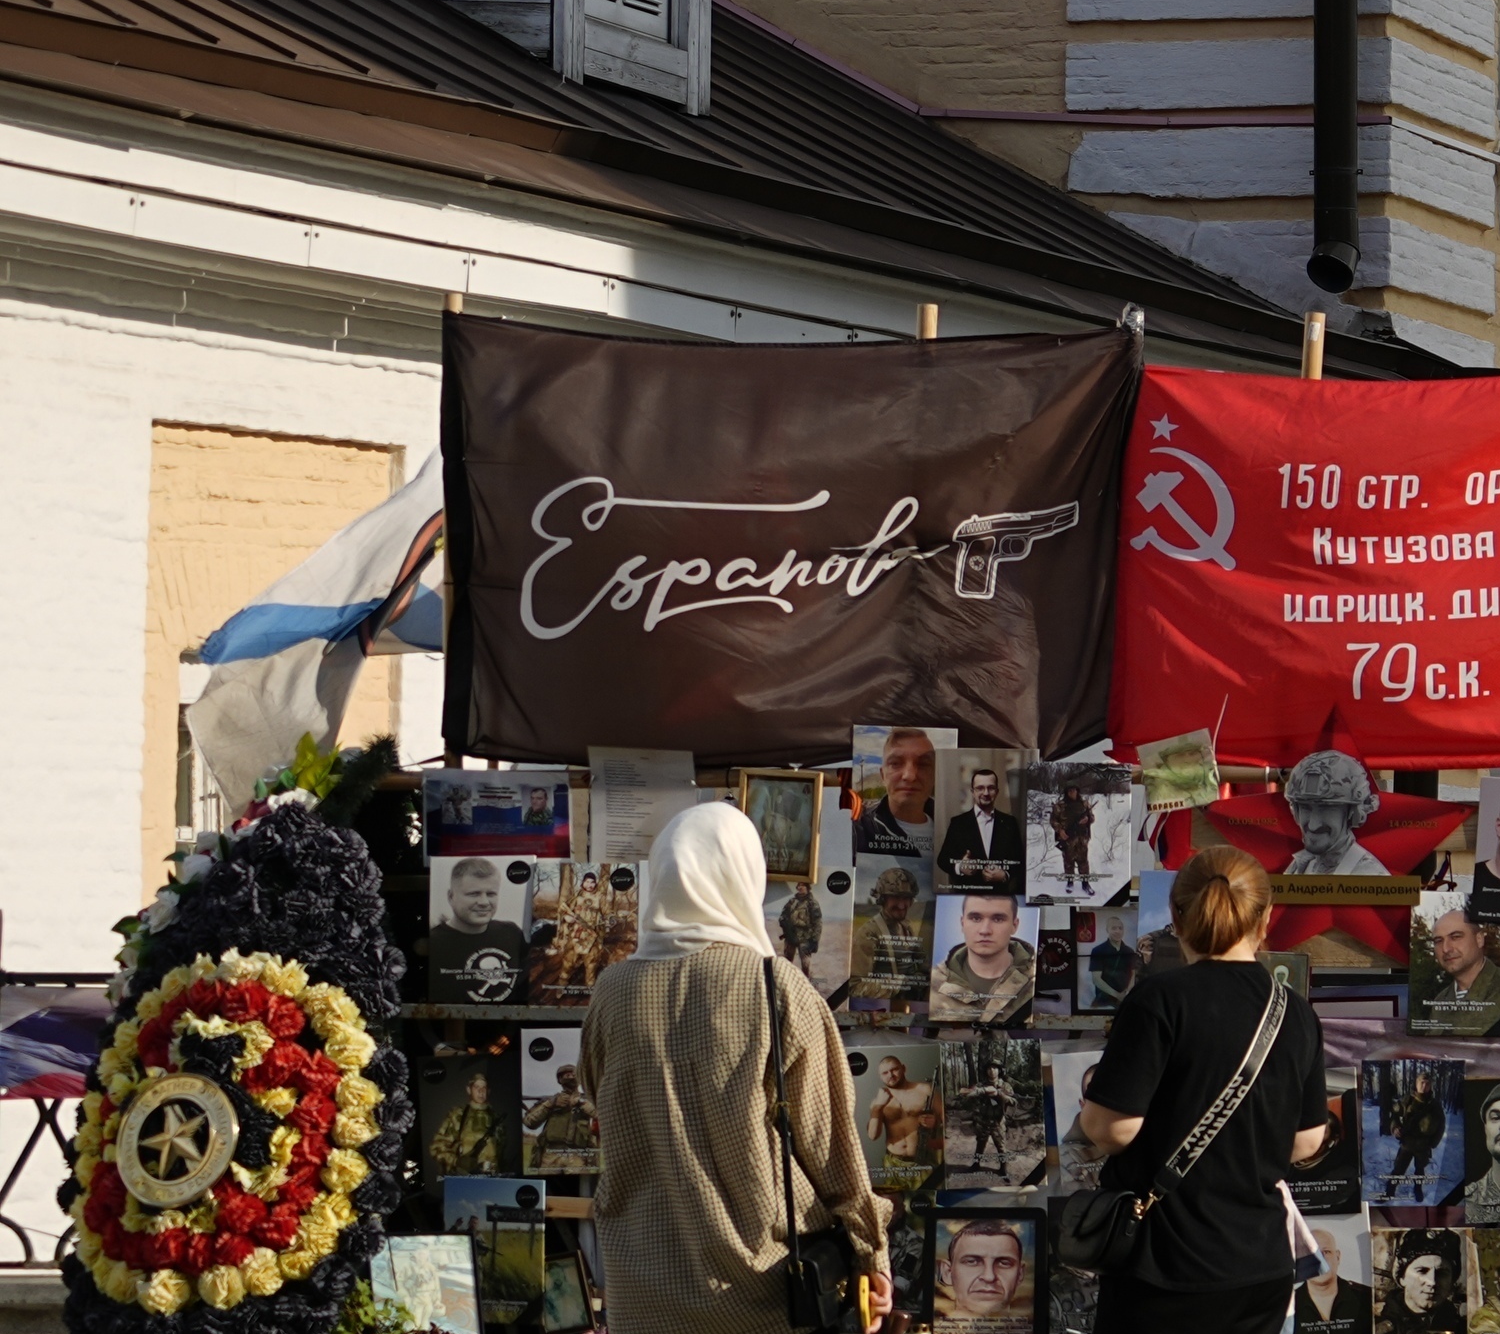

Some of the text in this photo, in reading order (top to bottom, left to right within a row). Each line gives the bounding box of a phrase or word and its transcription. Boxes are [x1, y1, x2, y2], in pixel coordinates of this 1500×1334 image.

[1277, 462, 1343, 510] 150
[1356, 473, 1430, 511] СТР.
[1283, 591, 1437, 625] ИДРИЦК.
[1286, 882, 1328, 897] Андрей
[1329, 882, 1420, 896] Леонардович
